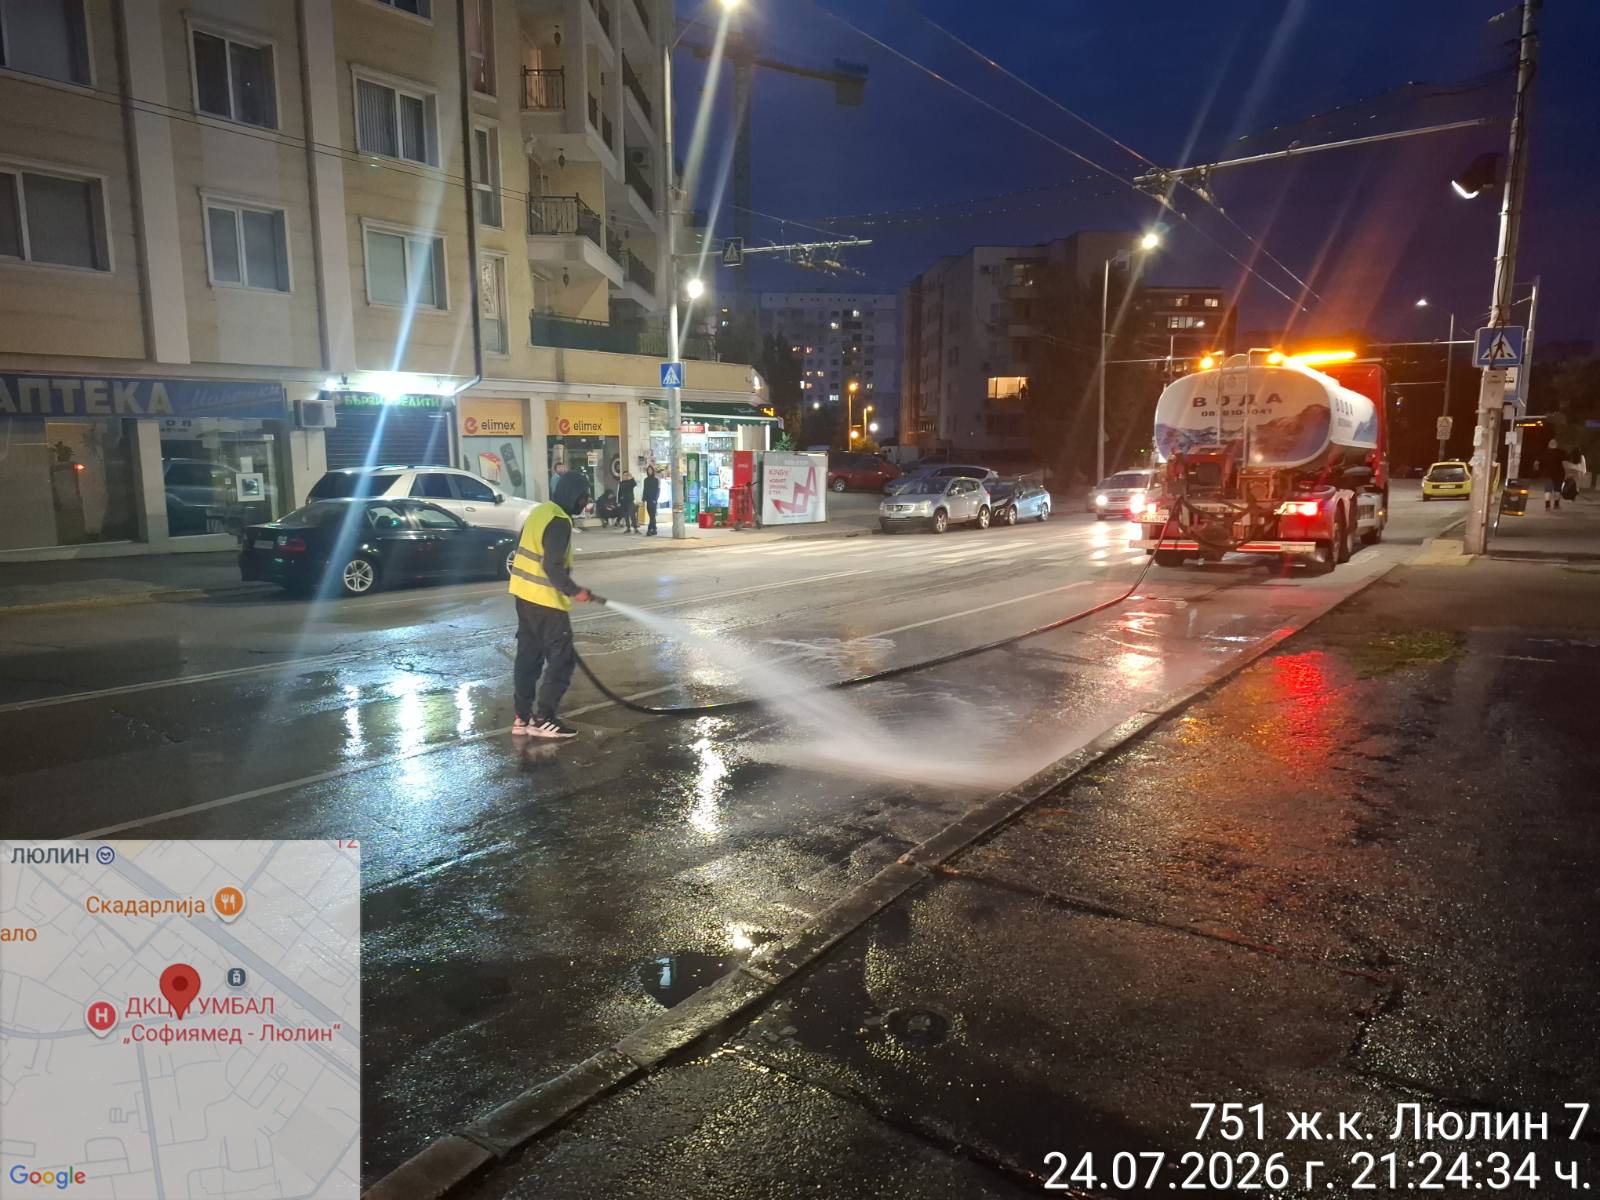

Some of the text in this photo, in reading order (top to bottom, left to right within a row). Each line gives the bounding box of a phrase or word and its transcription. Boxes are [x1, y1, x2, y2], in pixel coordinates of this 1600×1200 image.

[0, 376, 174, 415] АПТЕКА
[481, 418, 516, 431] elimex
[573, 419, 602, 431] elimex
